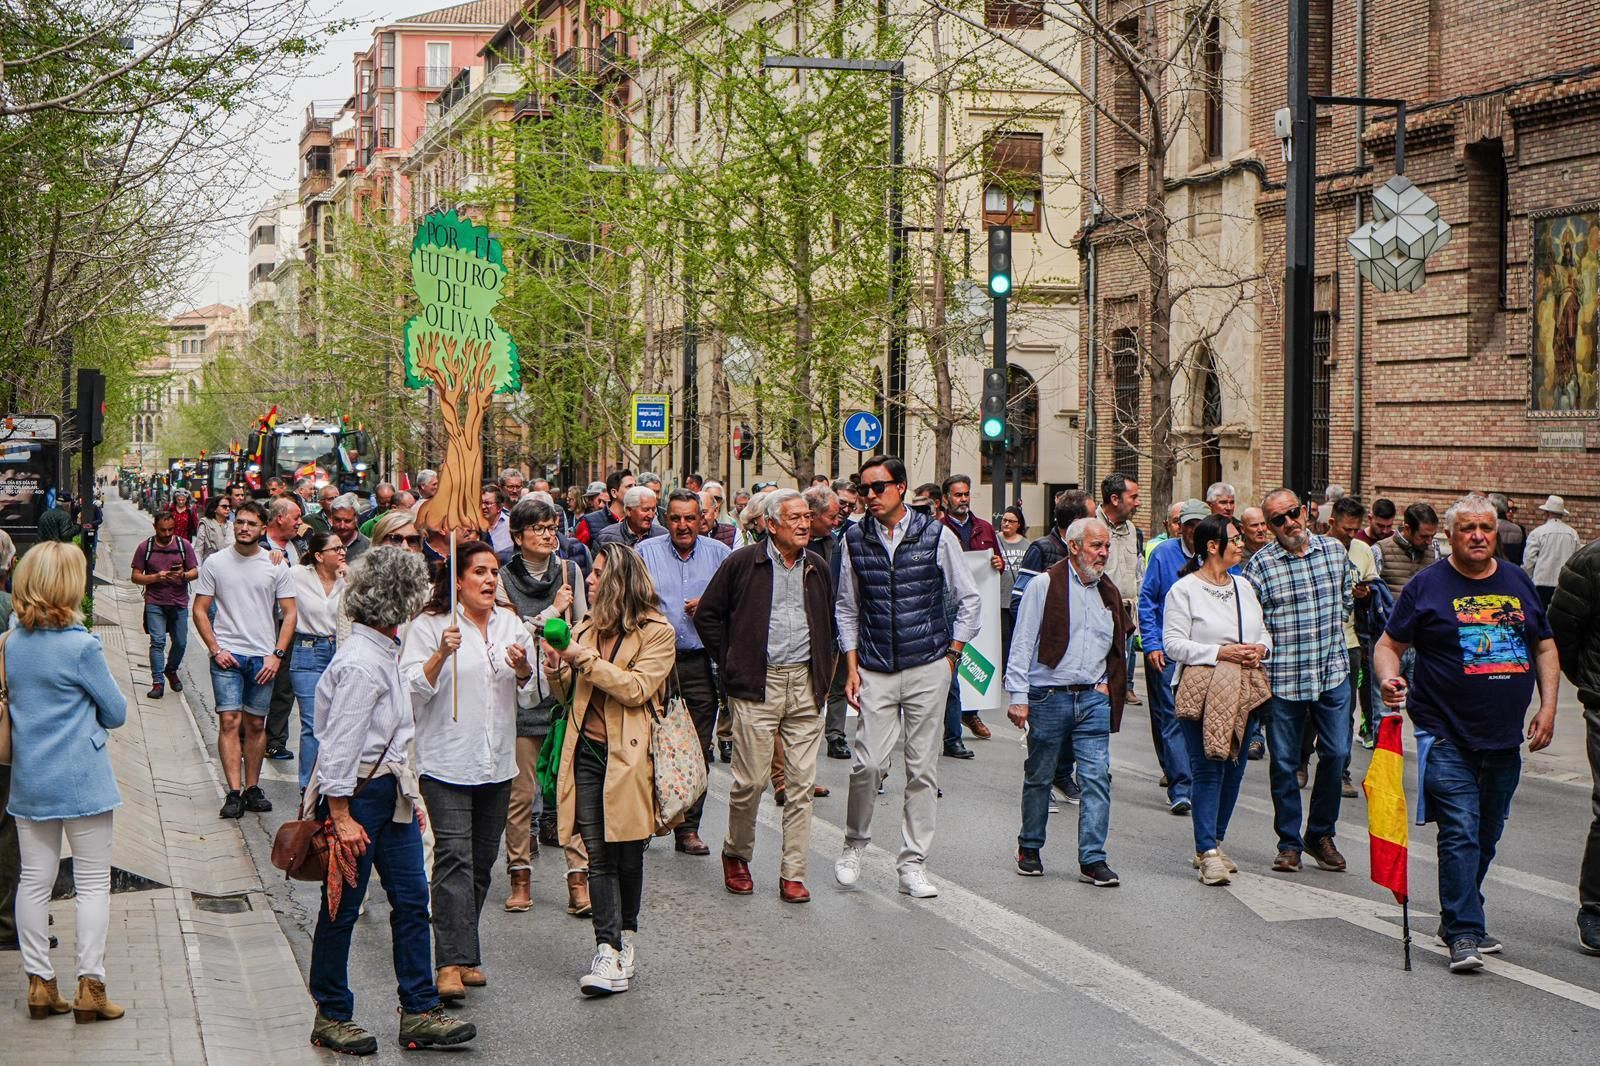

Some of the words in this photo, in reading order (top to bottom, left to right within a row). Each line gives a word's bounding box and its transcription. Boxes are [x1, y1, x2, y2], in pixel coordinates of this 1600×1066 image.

[427, 222, 459, 251] POR
[475, 236, 496, 263] EL
[420, 250, 498, 291] FUTURO
[437, 279, 472, 310] DEL
[426, 303, 496, 341] OLIVAR
[640, 420, 661, 428] TAXI
[967, 661, 988, 683] campo
